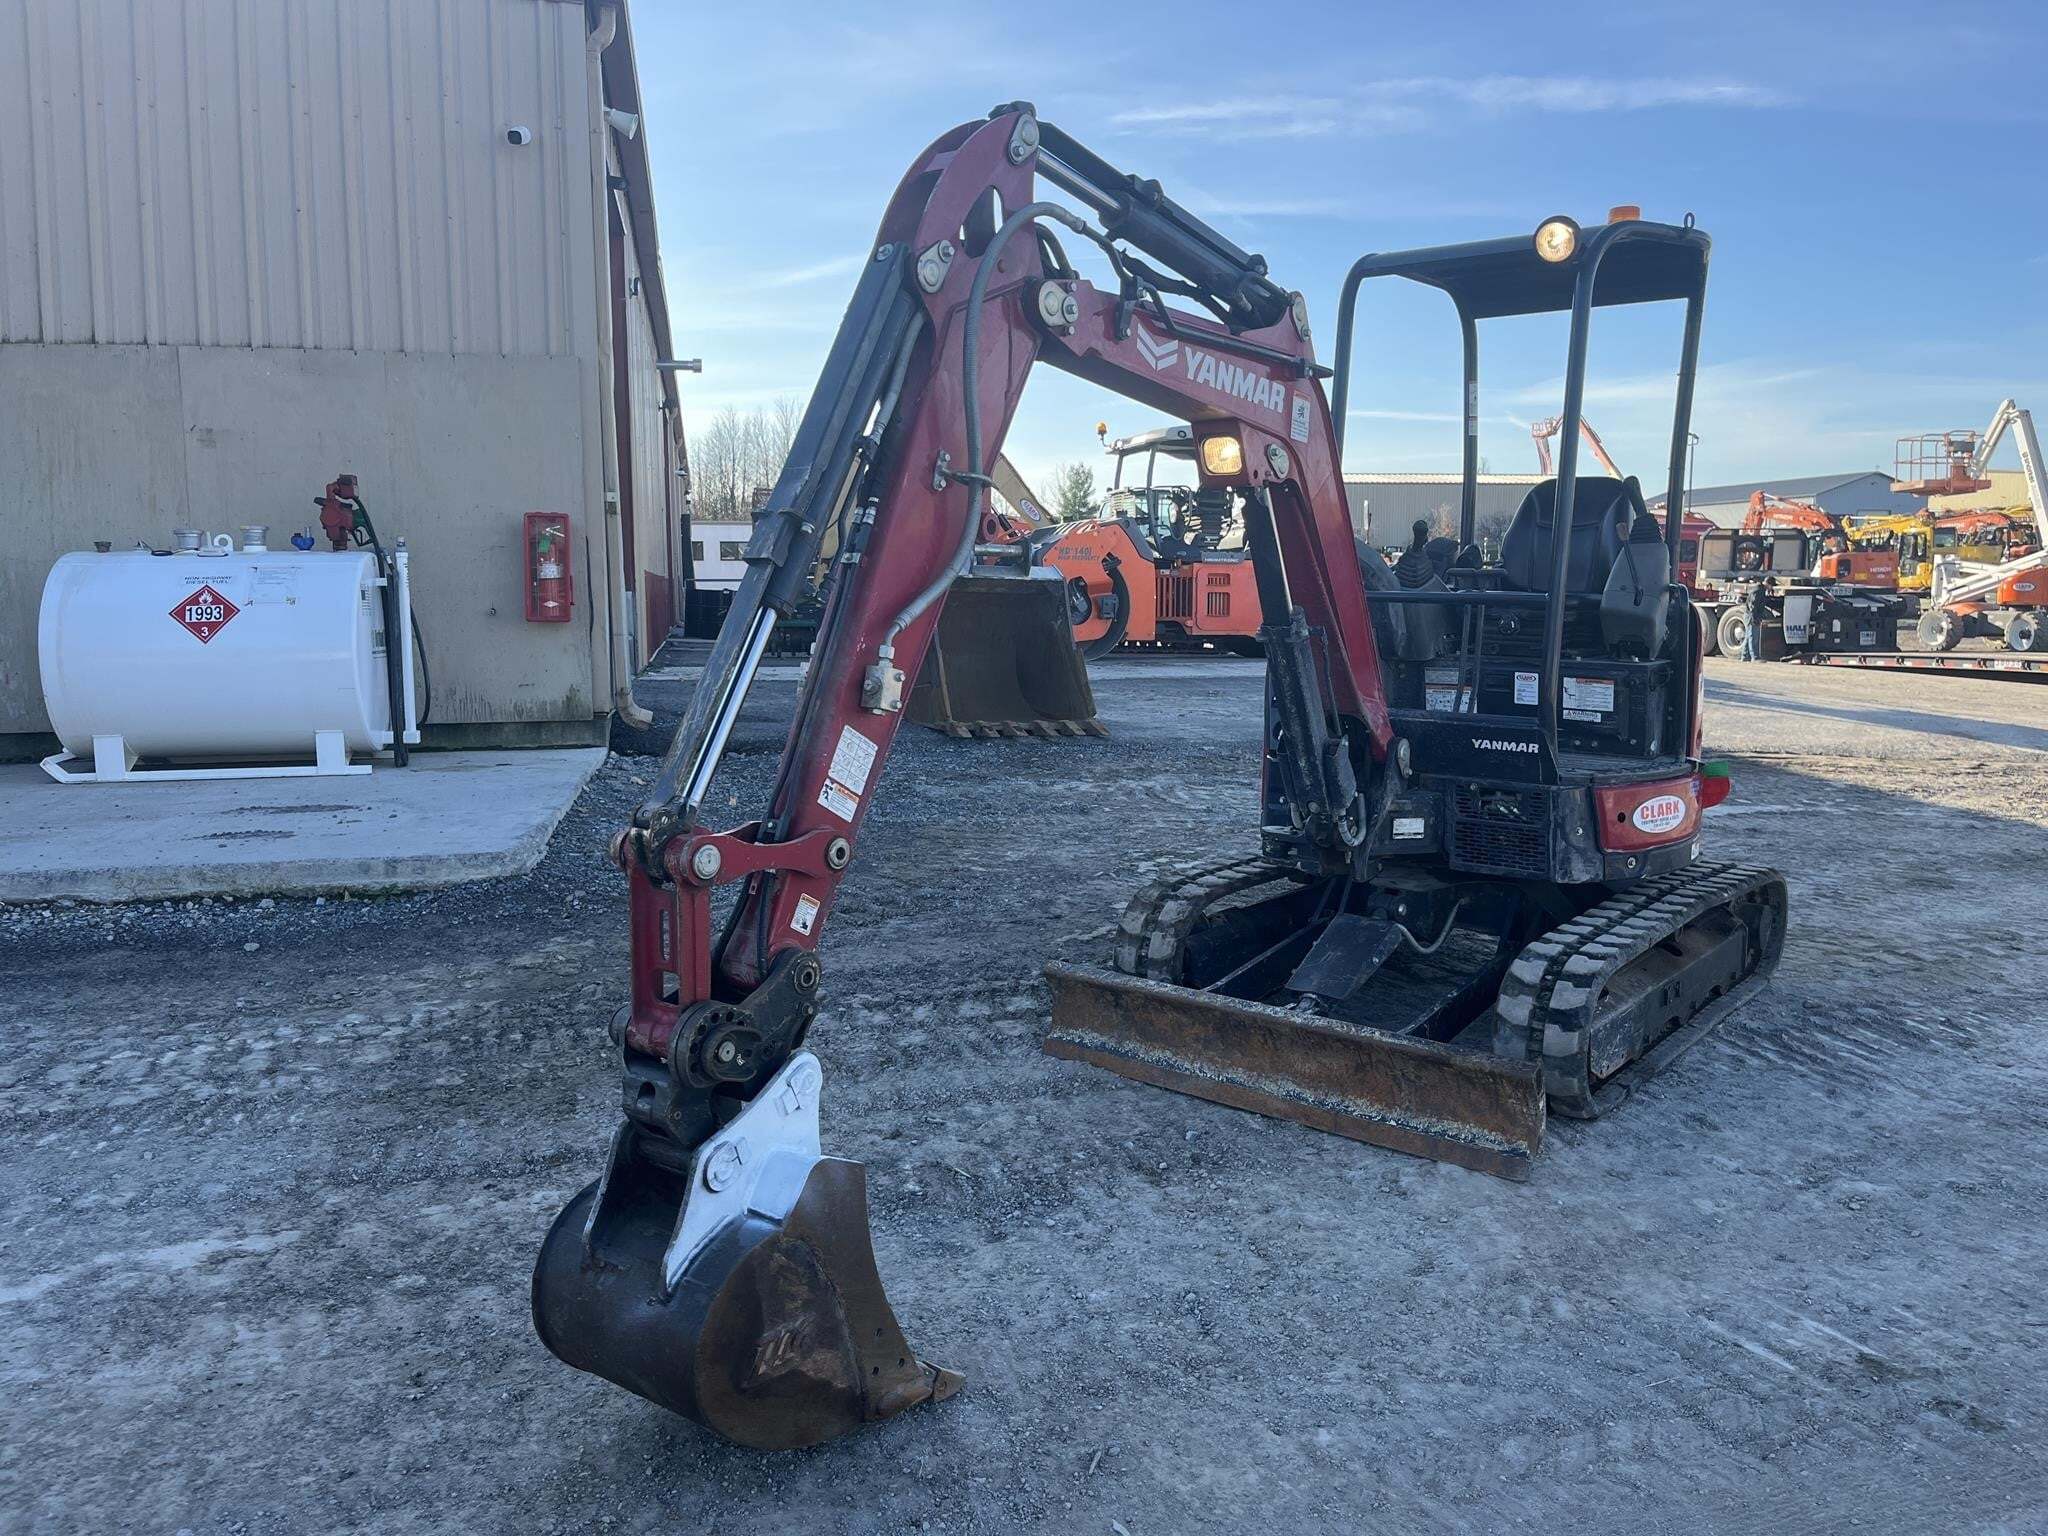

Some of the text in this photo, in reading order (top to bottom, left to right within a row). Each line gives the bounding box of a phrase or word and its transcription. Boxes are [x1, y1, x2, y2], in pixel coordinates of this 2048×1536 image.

[1184, 346, 1286, 413] YANMAR
[186, 606, 222, 621] 1993
[201, 627, 209, 637] 3
[1471, 738, 1540, 753] YANMAR
[1640, 800, 1680, 820] CLARK
